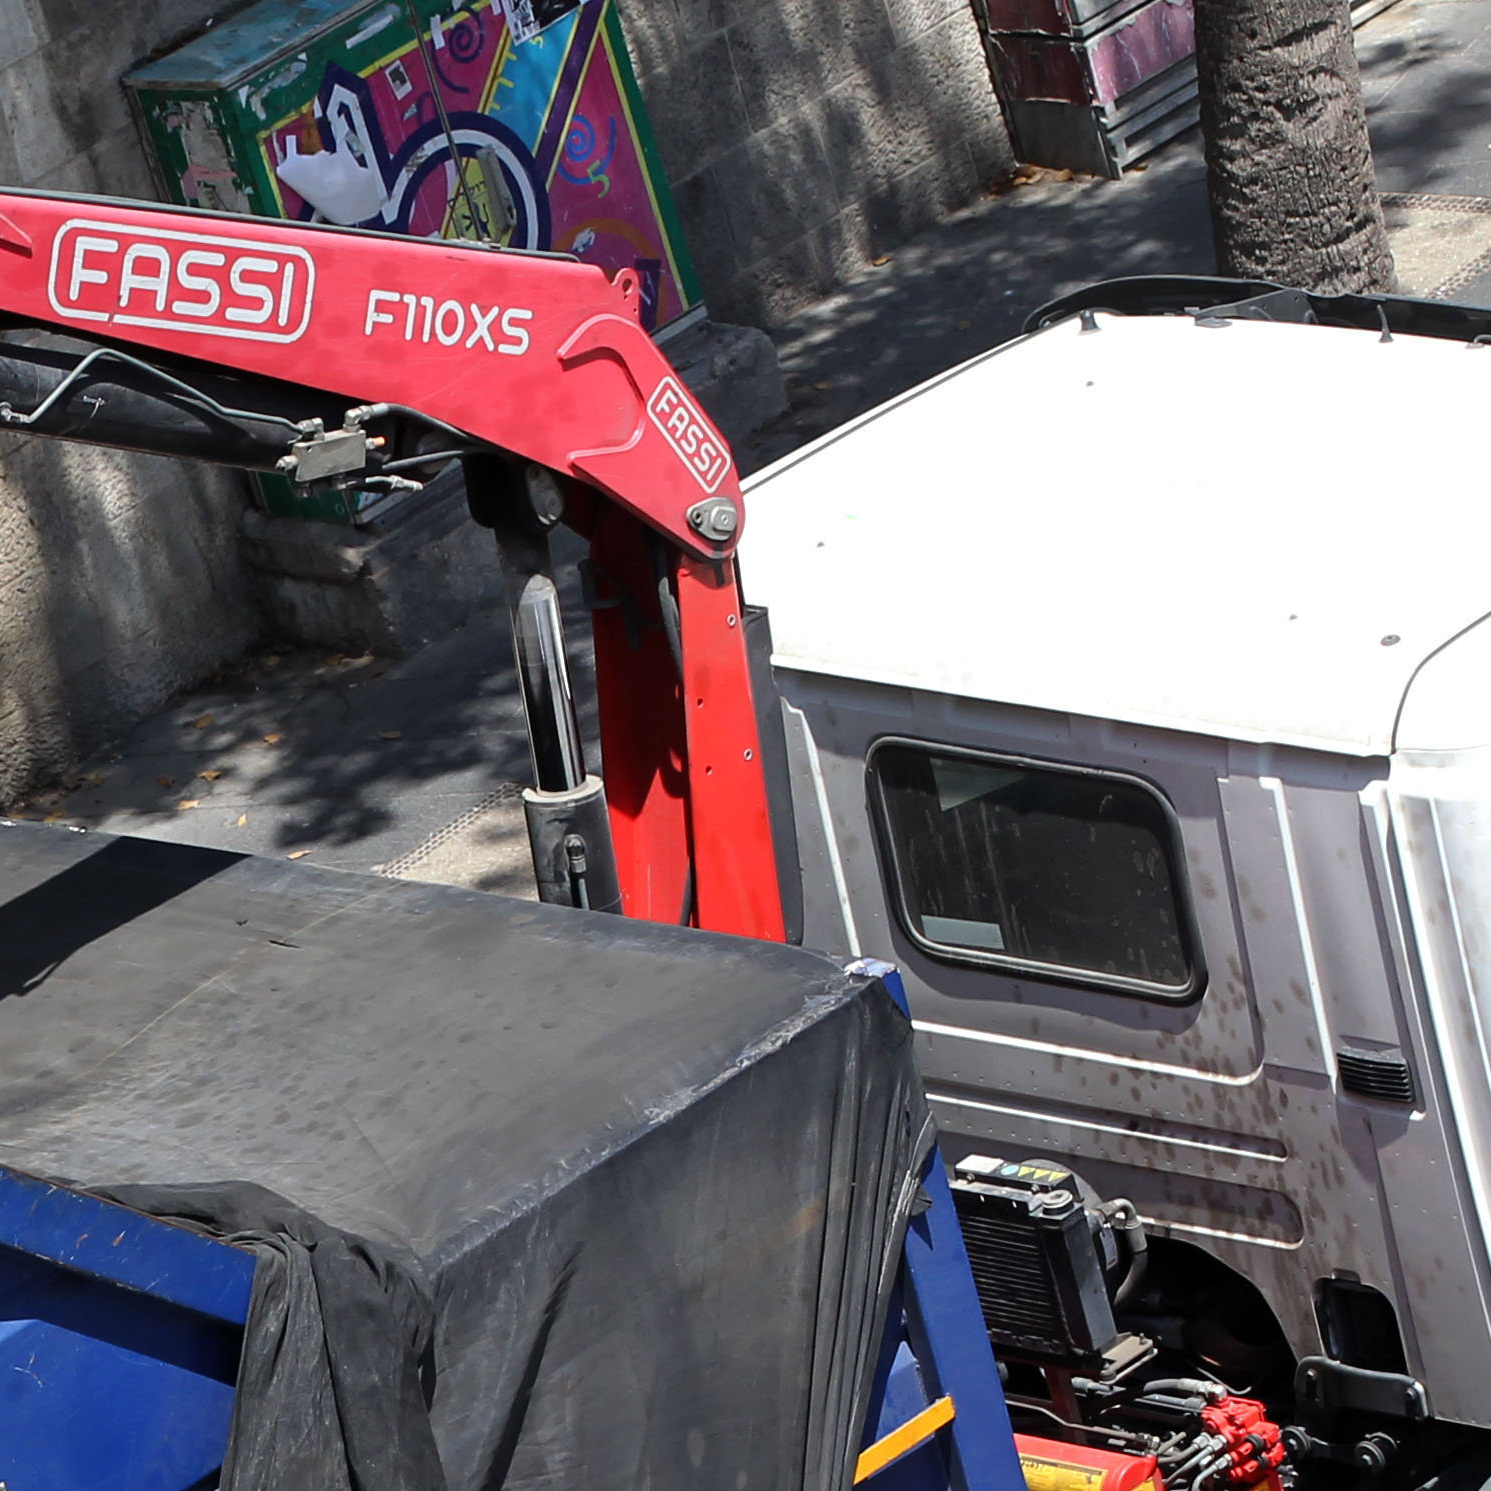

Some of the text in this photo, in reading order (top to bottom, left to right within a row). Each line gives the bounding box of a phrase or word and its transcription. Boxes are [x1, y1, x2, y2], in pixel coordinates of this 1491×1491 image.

[70, 236, 294, 326] FASSI
[365, 290, 534, 356] F110XS
[655, 390, 721, 487] FASSI
